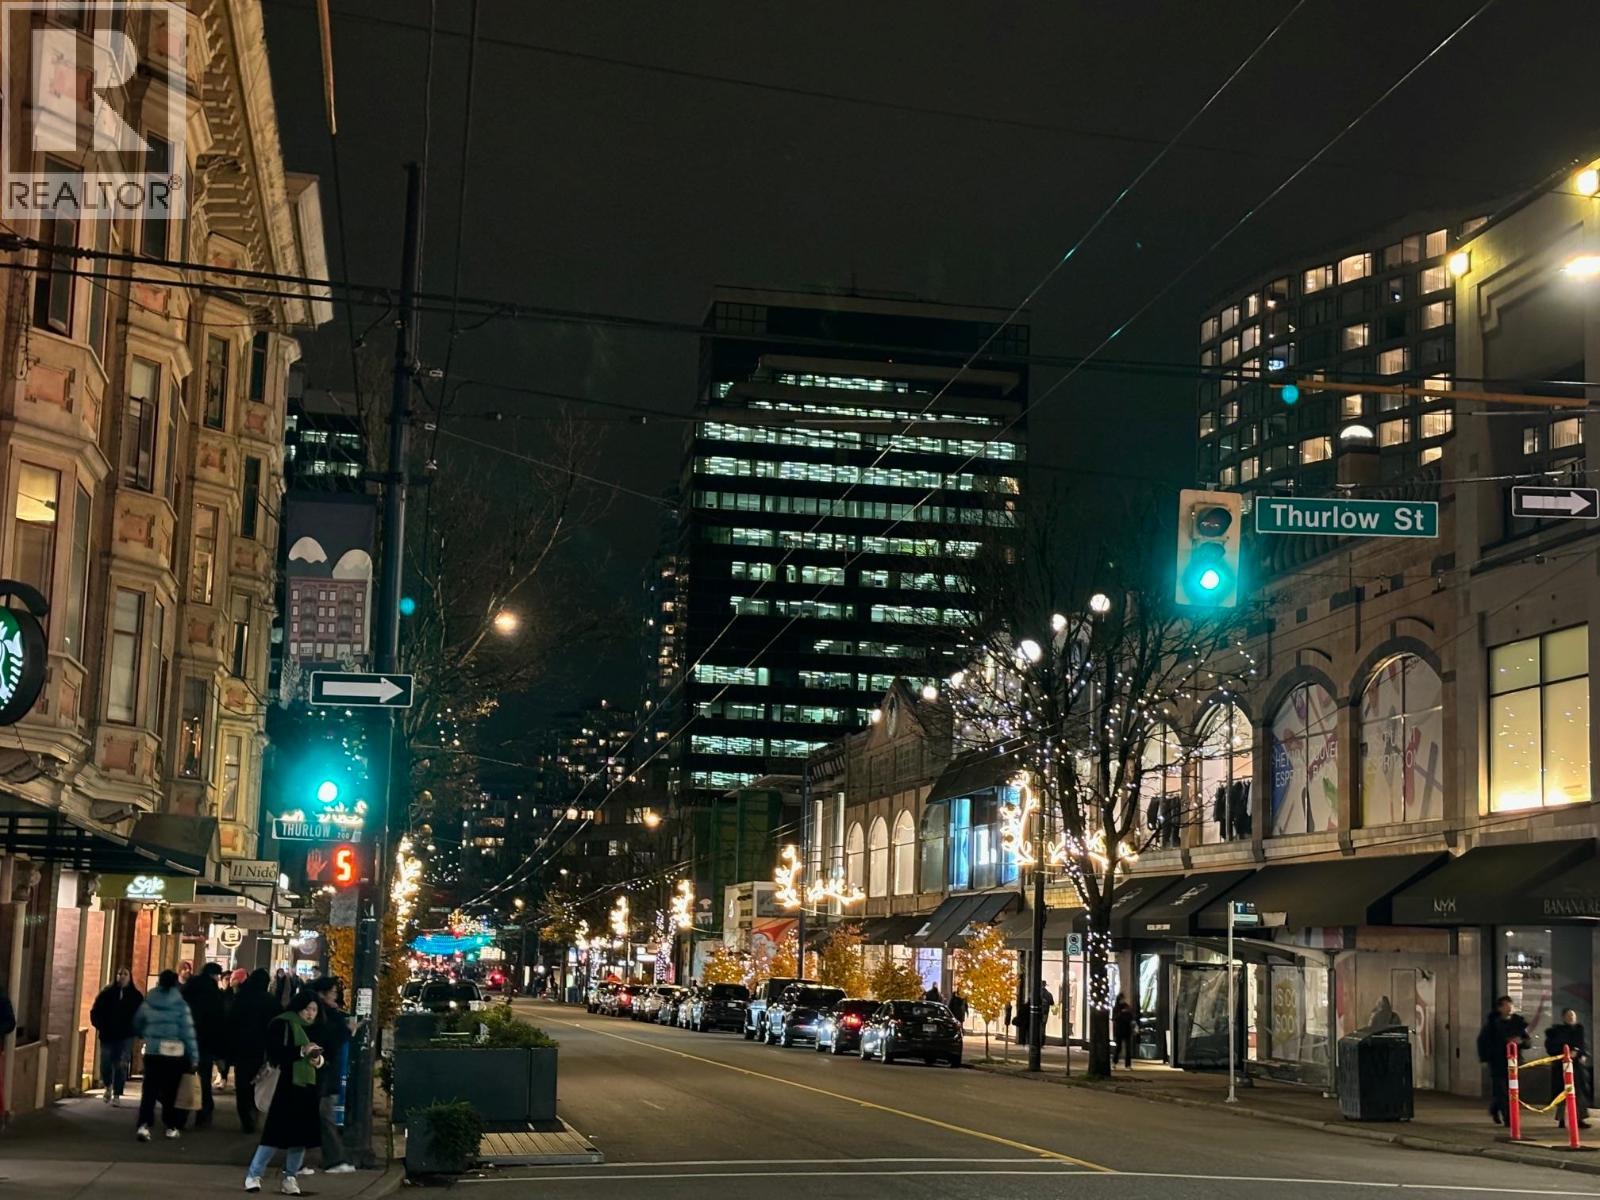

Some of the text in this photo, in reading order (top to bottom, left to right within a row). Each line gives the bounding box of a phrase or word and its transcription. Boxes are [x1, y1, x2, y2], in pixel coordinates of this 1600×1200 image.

[1270, 504, 1424, 531] Thurlow St
[282, 822, 330, 838] THURLOW
[233, 865, 276, 879] Il Nido
[336, 849, 352, 881] 5
[1433, 897, 1456, 912] NYX
[1543, 898, 1586, 914] BANANA
